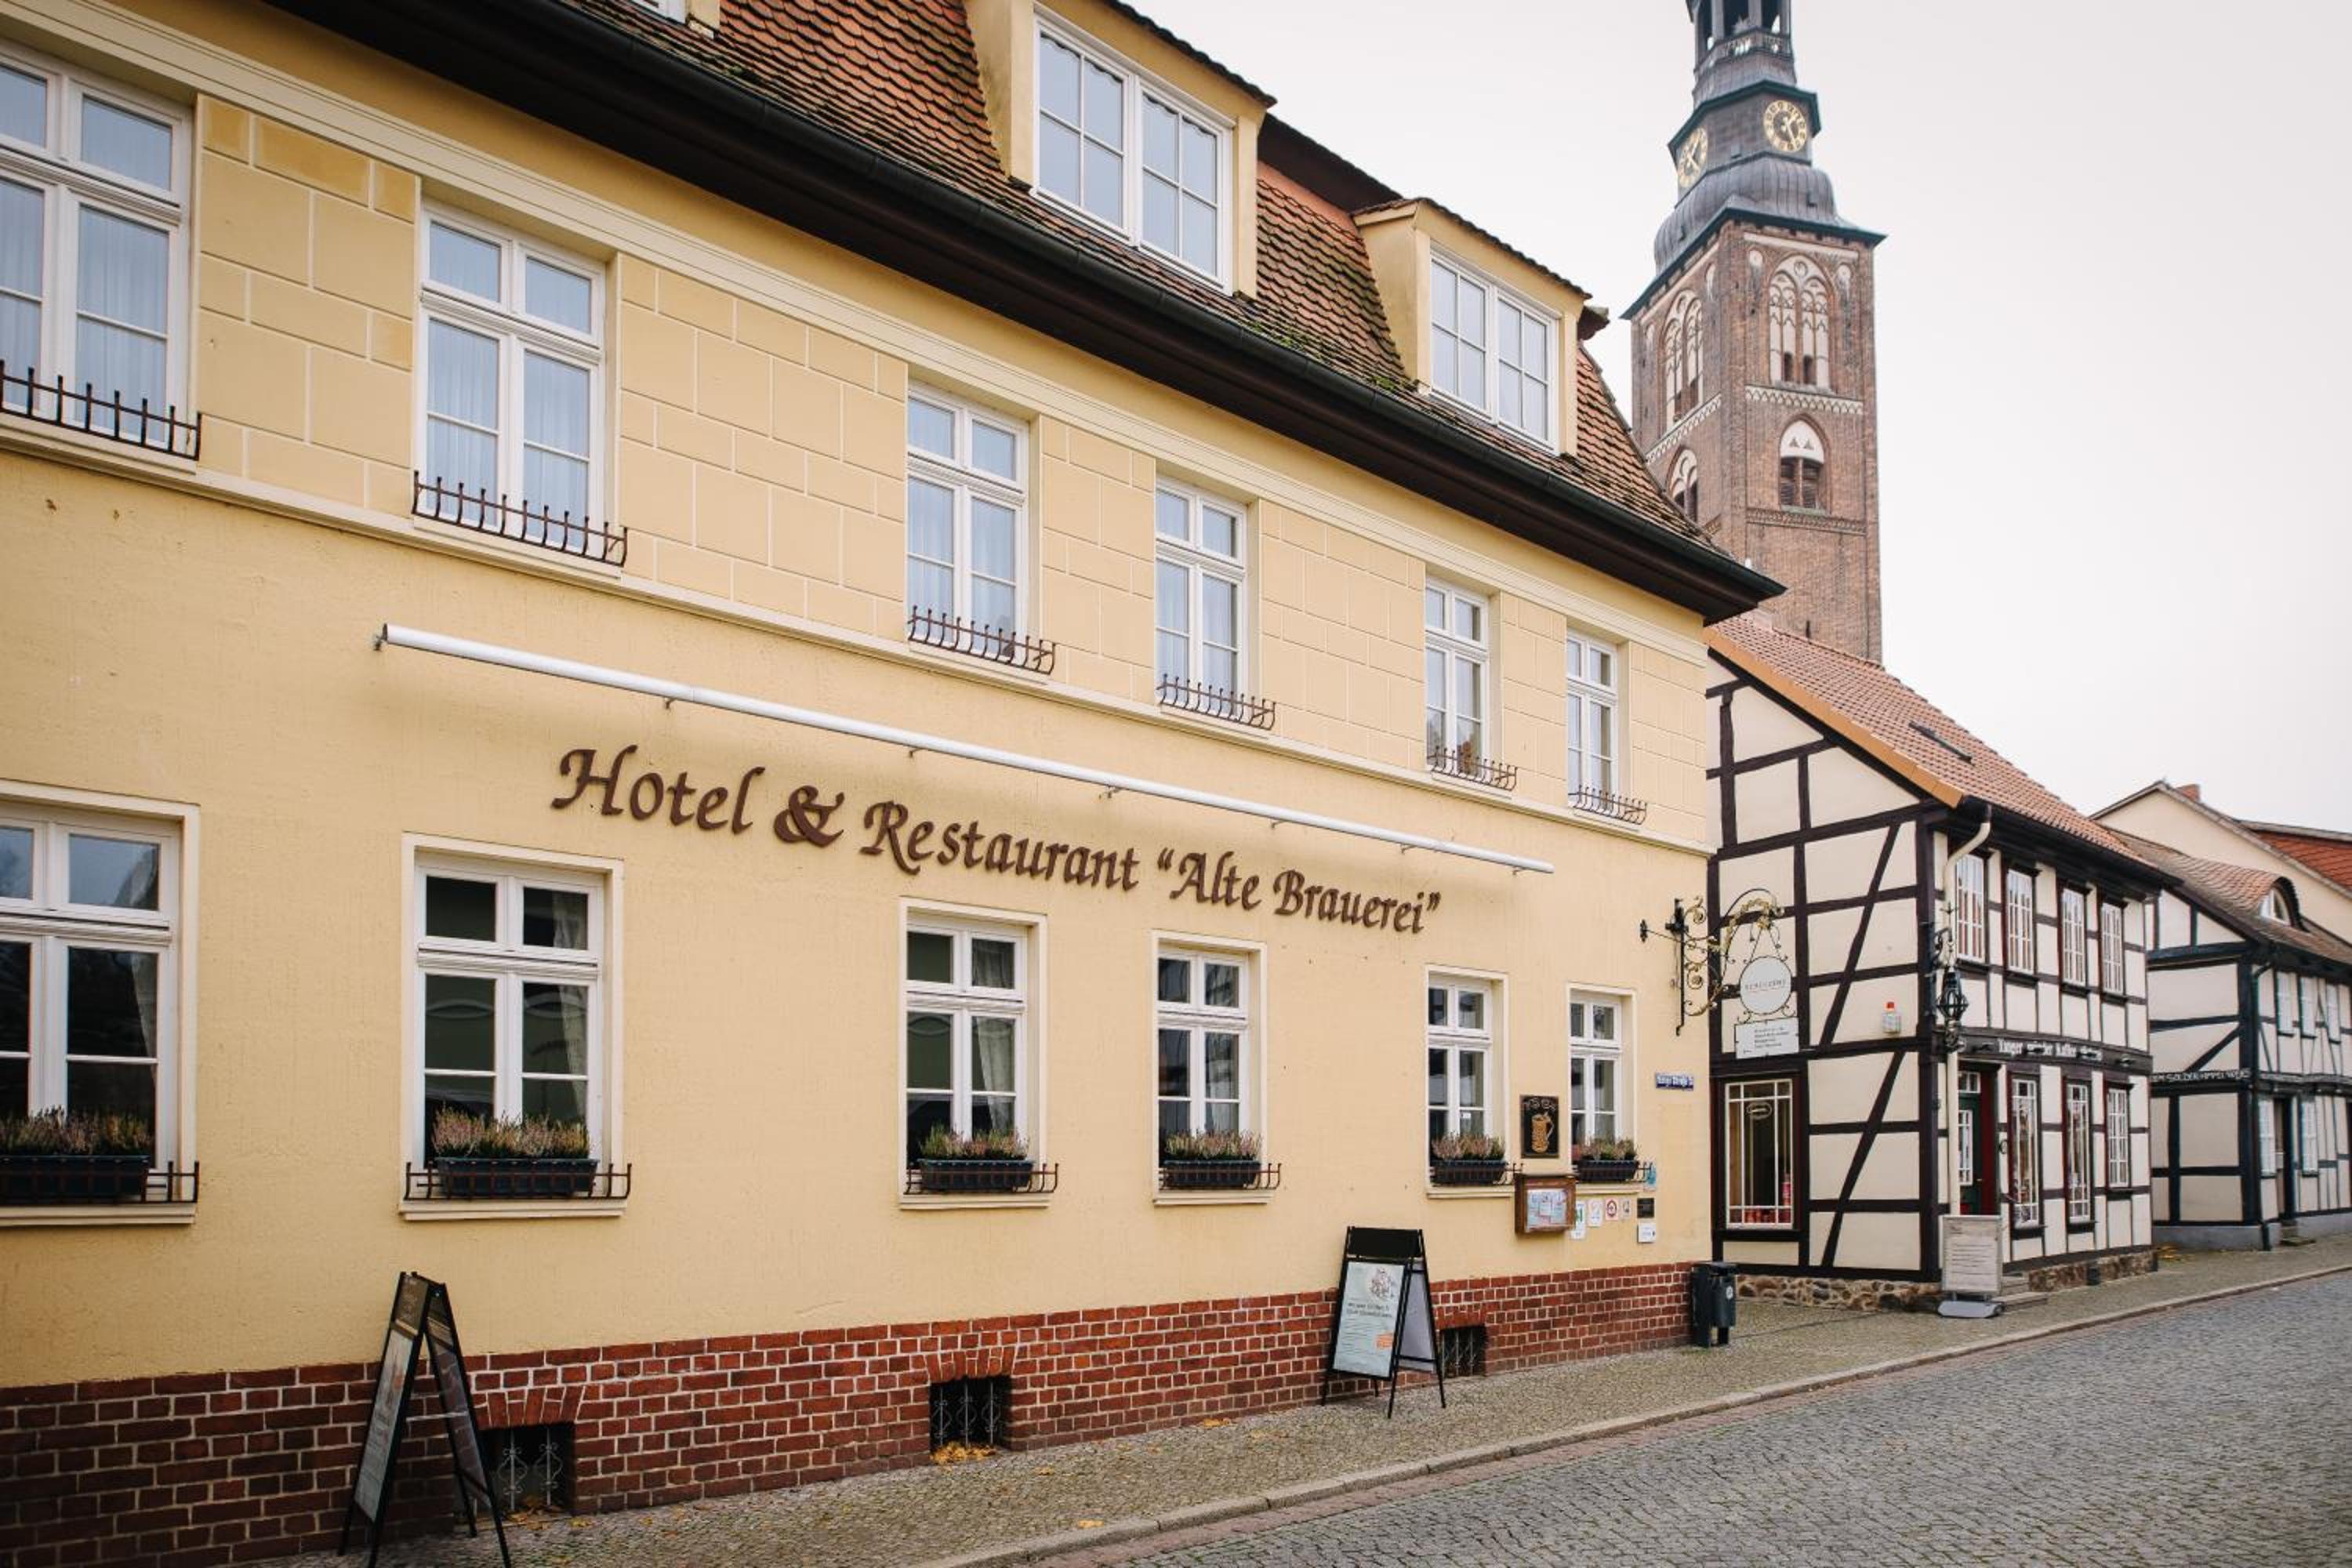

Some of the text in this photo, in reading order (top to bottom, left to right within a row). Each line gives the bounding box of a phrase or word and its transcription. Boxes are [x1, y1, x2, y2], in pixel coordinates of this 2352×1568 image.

[551, 744, 766, 836] Hotel
[773, 785, 845, 849] &
[859, 800, 1141, 892] Restaurant
